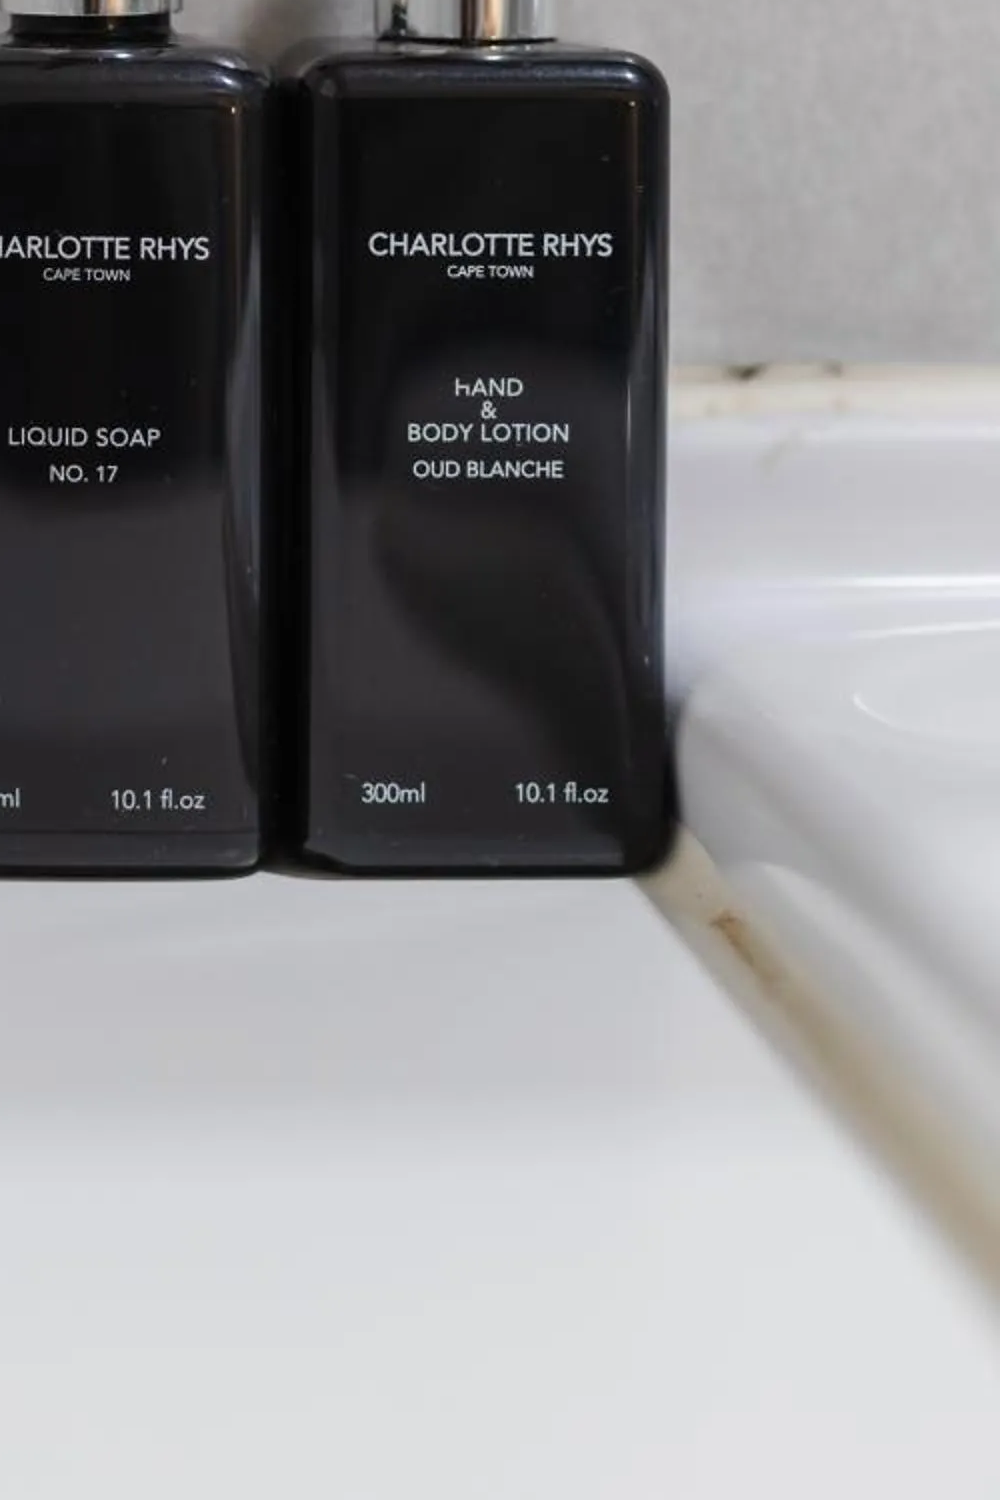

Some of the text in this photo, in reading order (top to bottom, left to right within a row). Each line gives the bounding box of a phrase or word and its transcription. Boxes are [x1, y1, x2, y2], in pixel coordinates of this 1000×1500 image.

[139, 235, 211, 261] RHYS
[367, 231, 614, 258] CHARLOTTE RHYS
[42, 267, 132, 282] CAPE TOWN
[446, 264, 535, 279] CAPE TOWN
[480, 399, 497, 420] &
[7, 426, 162, 448] LIQUID SOAP
[407, 422, 570, 444] BODY LOTION
[49, 464, 119, 484] NO. 17
[412, 459, 565, 480] OUD BLANCHE
[110, 787, 206, 811] 10.1 fl.oz
[361, 781, 426, 804] 300ml
[515, 781, 610, 804] 10.1 fl.oz
